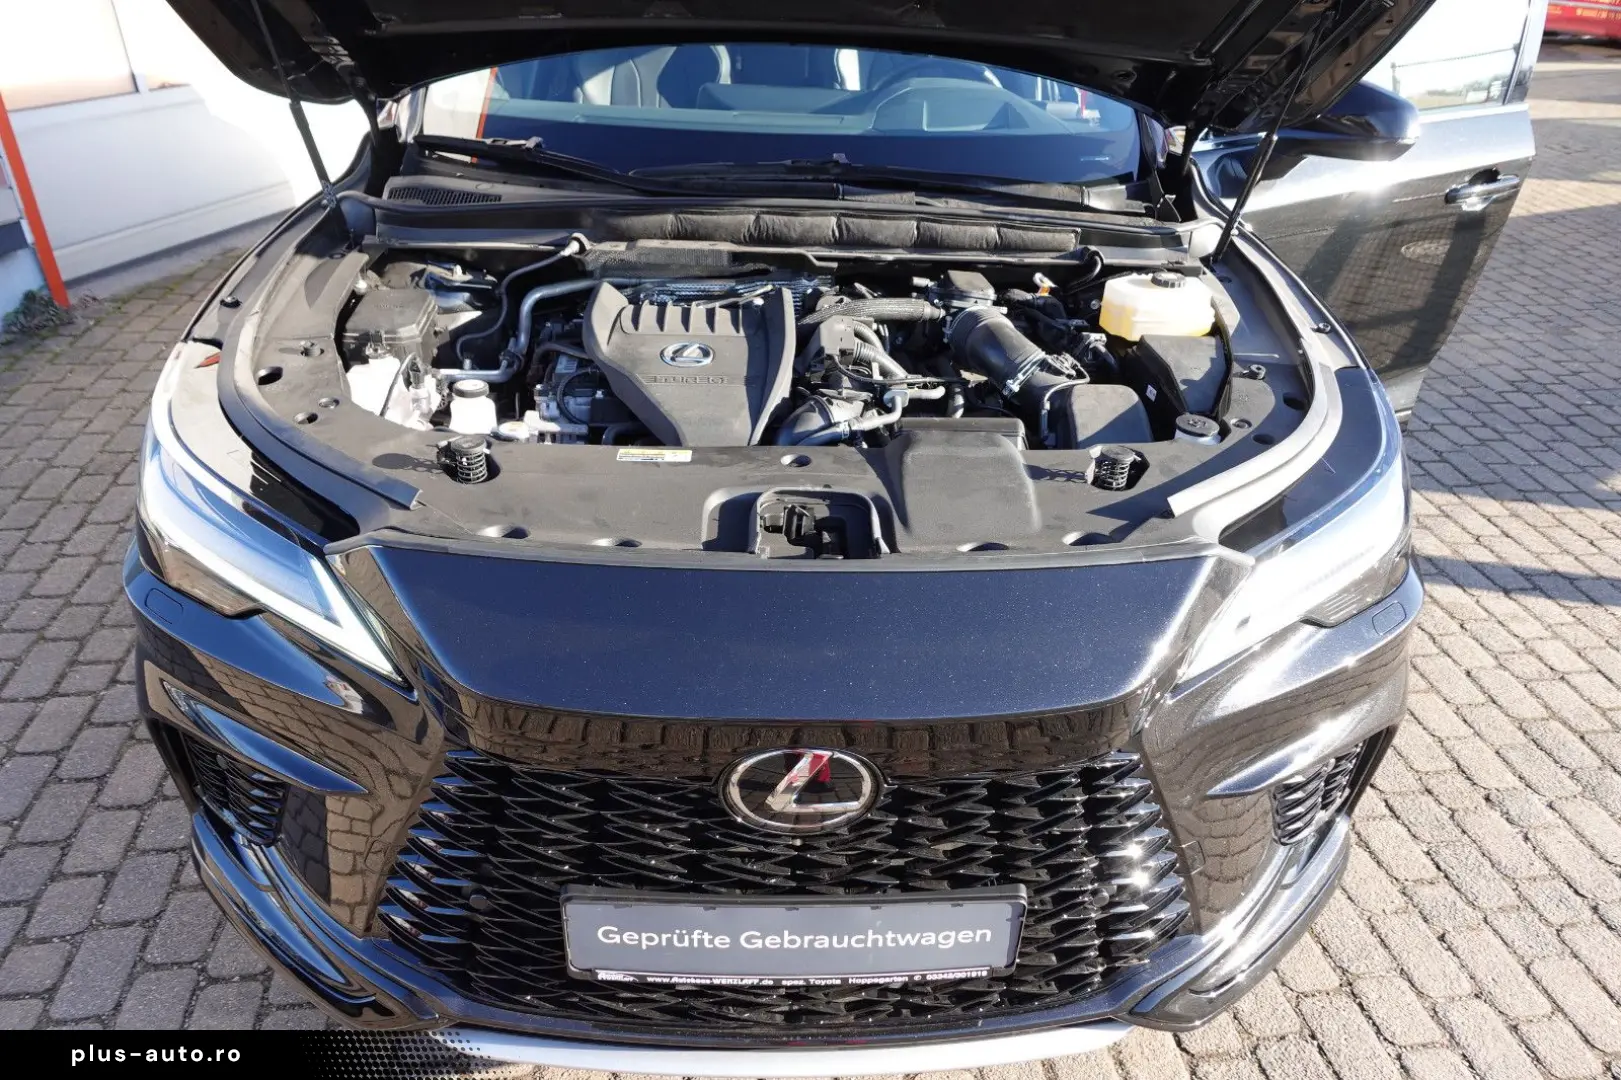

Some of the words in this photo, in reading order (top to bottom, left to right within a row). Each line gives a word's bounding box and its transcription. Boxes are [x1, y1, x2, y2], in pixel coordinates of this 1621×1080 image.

[597, 925, 731, 949] Geprüfte
[739, 929, 992, 950] Gebrauchtwagen
[808, 978, 842, 986] Toyota
